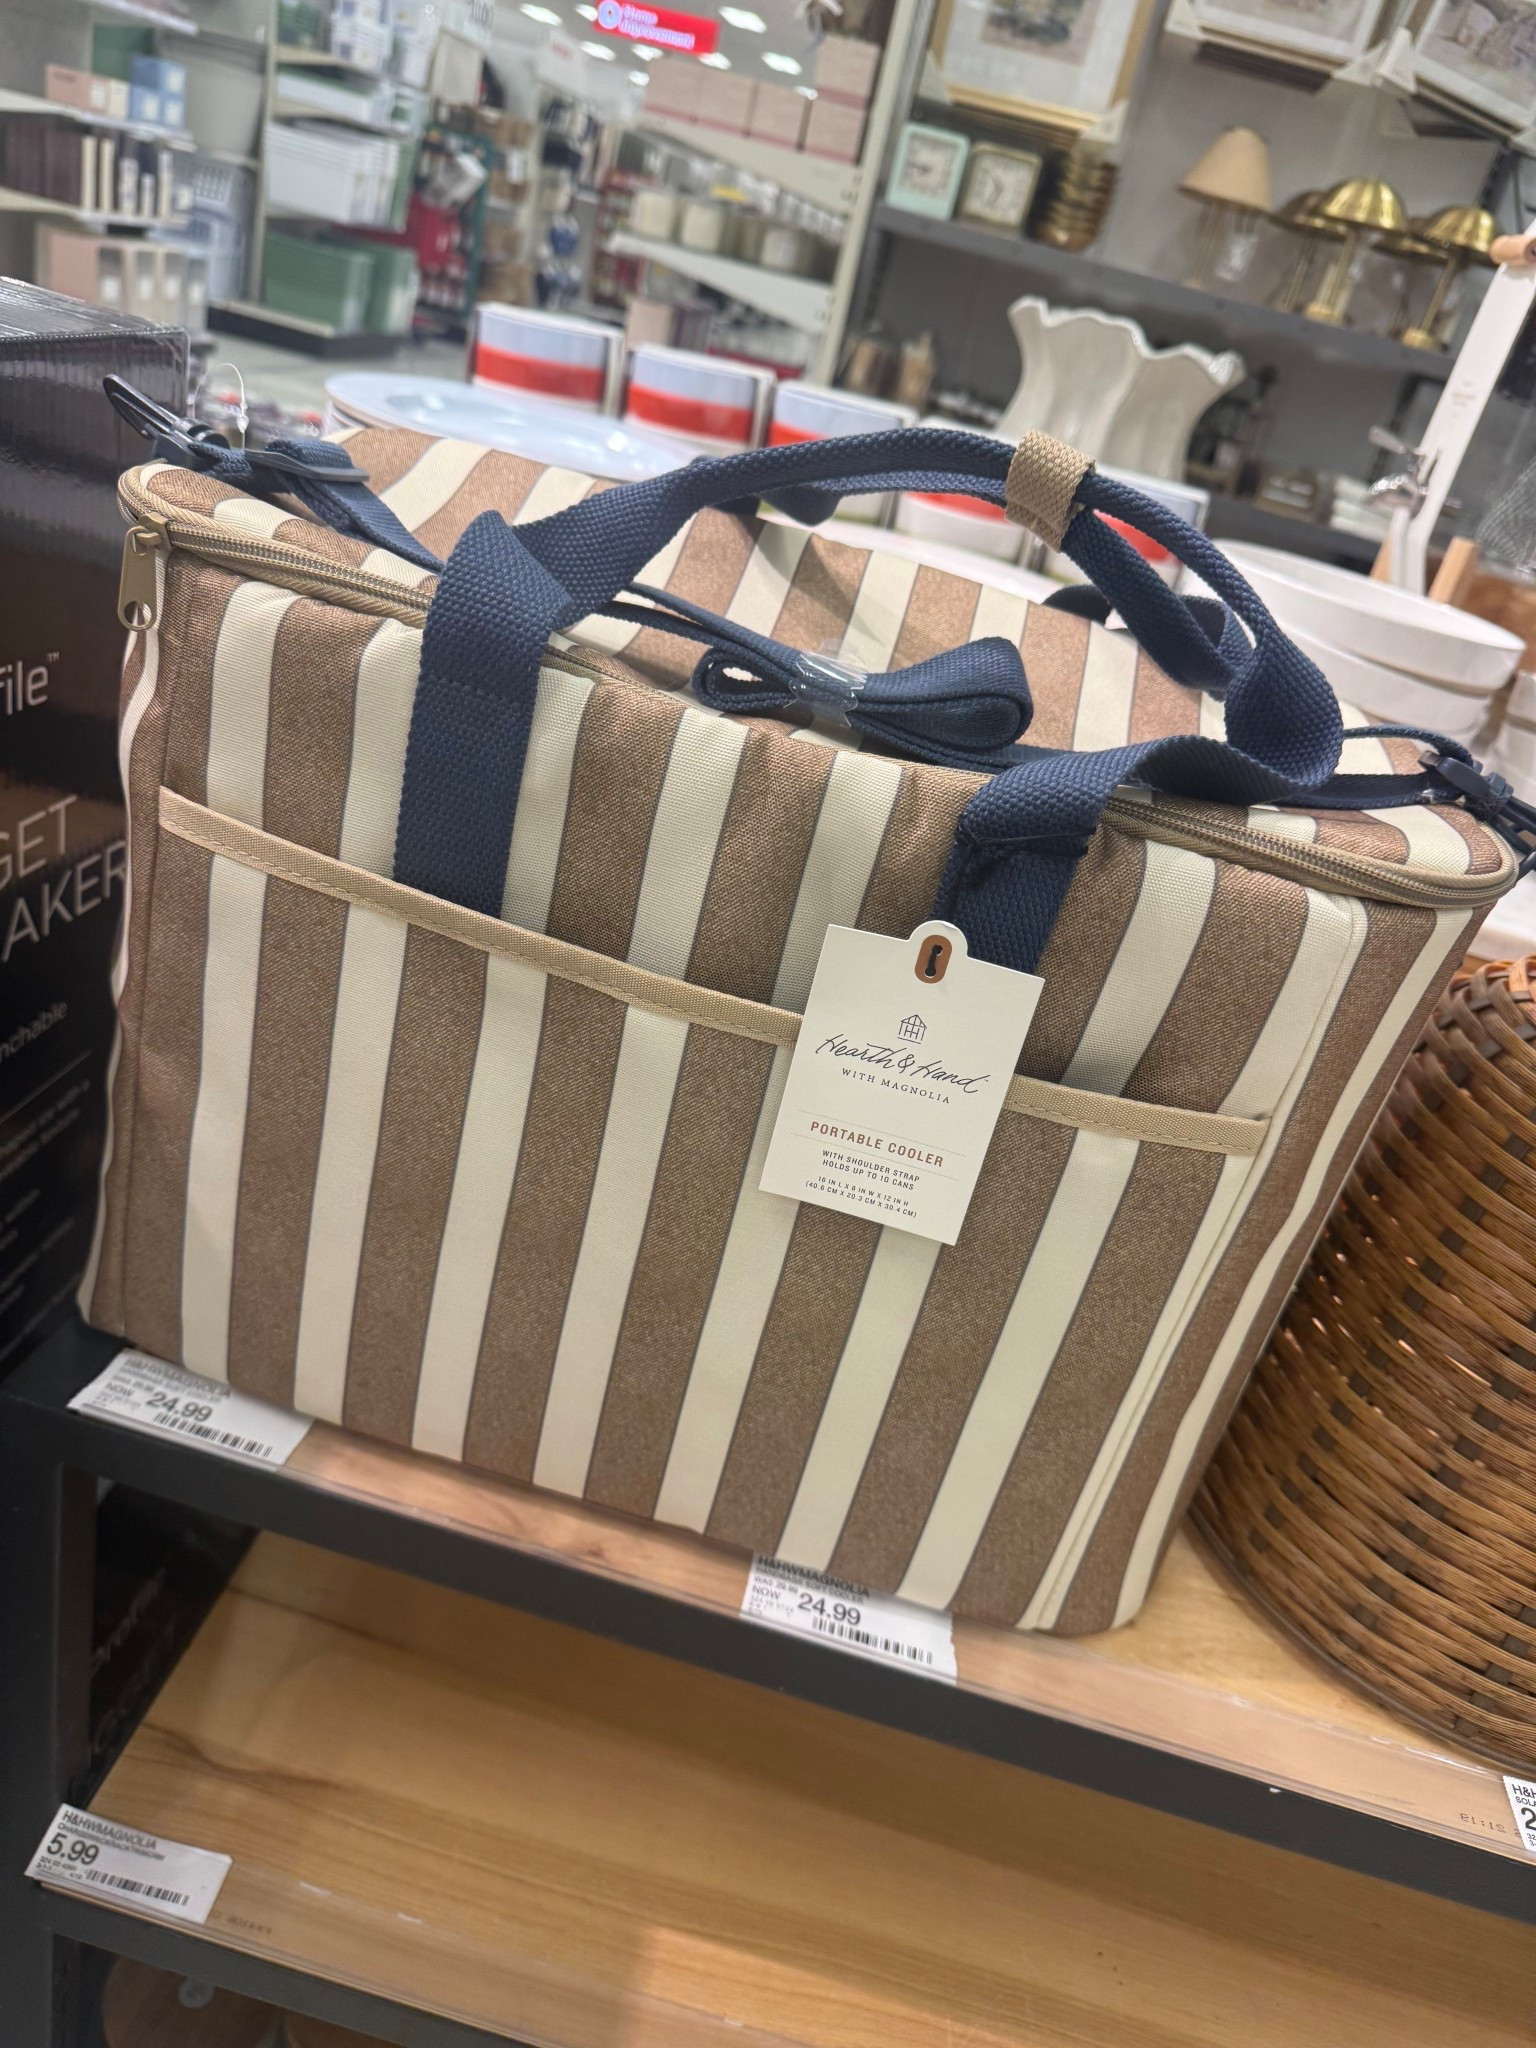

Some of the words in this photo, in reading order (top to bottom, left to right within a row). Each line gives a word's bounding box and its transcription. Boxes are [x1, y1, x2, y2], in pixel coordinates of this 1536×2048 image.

[815, 1033, 908, 1069] Hearth
[897, 1053, 916, 1074] &
[909, 1060, 991, 1094] Hand
[842, 1067, 876, 1083] WITH
[881, 1078, 950, 1104] MAGNOLIA
[810, 1121, 884, 1150] PORTABLE
[888, 1142, 944, 1168] COOLER
[822, 1149, 844, 1161] WITH
[846, 1156, 891, 1174] SHOULDER
[892, 1169, 920, 1182] STRAP
[822, 1159, 850, 1172] HOLDS
[852, 1167, 864, 1175] UP
[867, 1171, 877, 1180] TO
[880, 1175, 889, 1183] 10
[892, 1178, 914, 1191] CANS
[805, 1180, 825, 1191] (40.6
[846, 1192, 863, 1202] 20.3
[864, 1197, 876, 1205] CM
[884, 1203, 901, 1213] 30.4
[902, 1208, 918, 1218] CM)
[893, 1197, 901, 1205] IN
[105, 1382, 135, 1399] NOW
[146, 1391, 213, 1422] 24.99
[758, 1555, 870, 1597] H&HWMAGNOLIA
[752, 1585, 781, 1600] NOW
[798, 1592, 861, 1625] 24.99
[1520, 1807, 1536, 1831] 2
[47, 1832, 99, 1865] 5.99
